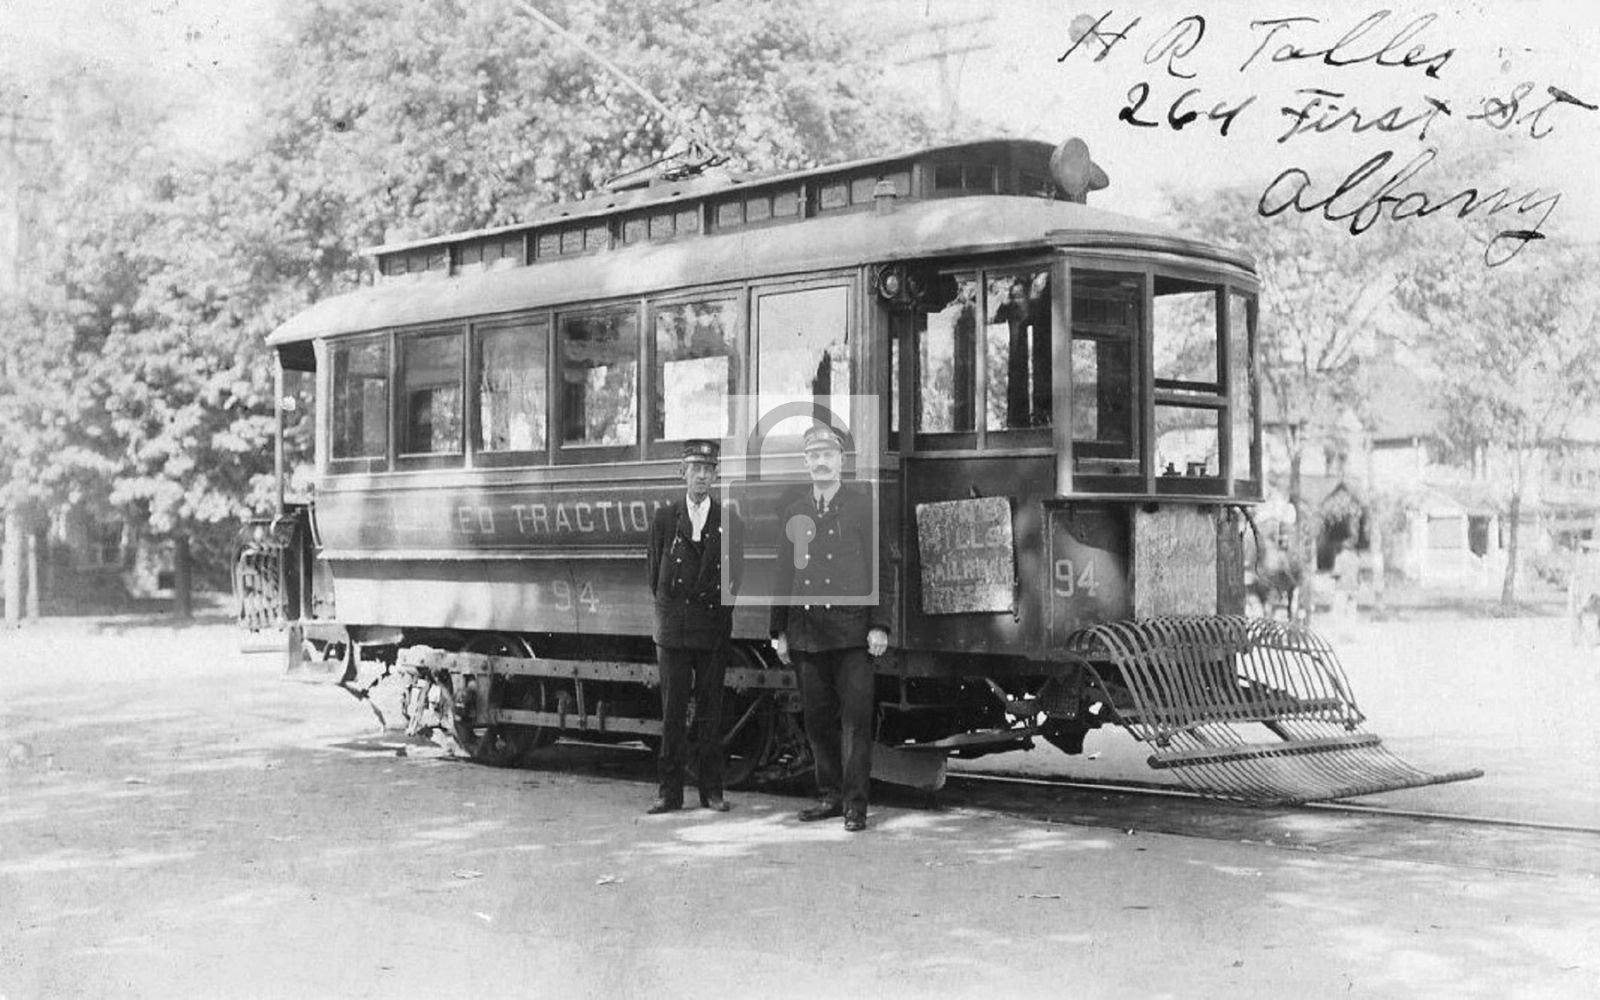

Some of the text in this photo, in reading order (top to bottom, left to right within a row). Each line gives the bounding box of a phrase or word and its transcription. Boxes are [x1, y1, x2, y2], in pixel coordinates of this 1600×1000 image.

[1118, 81, 1600, 143] 264 First St
[511, 501, 672, 534] TRACTIO
[553, 579, 601, 614] 94
[1055, 558, 1100, 598] 94
